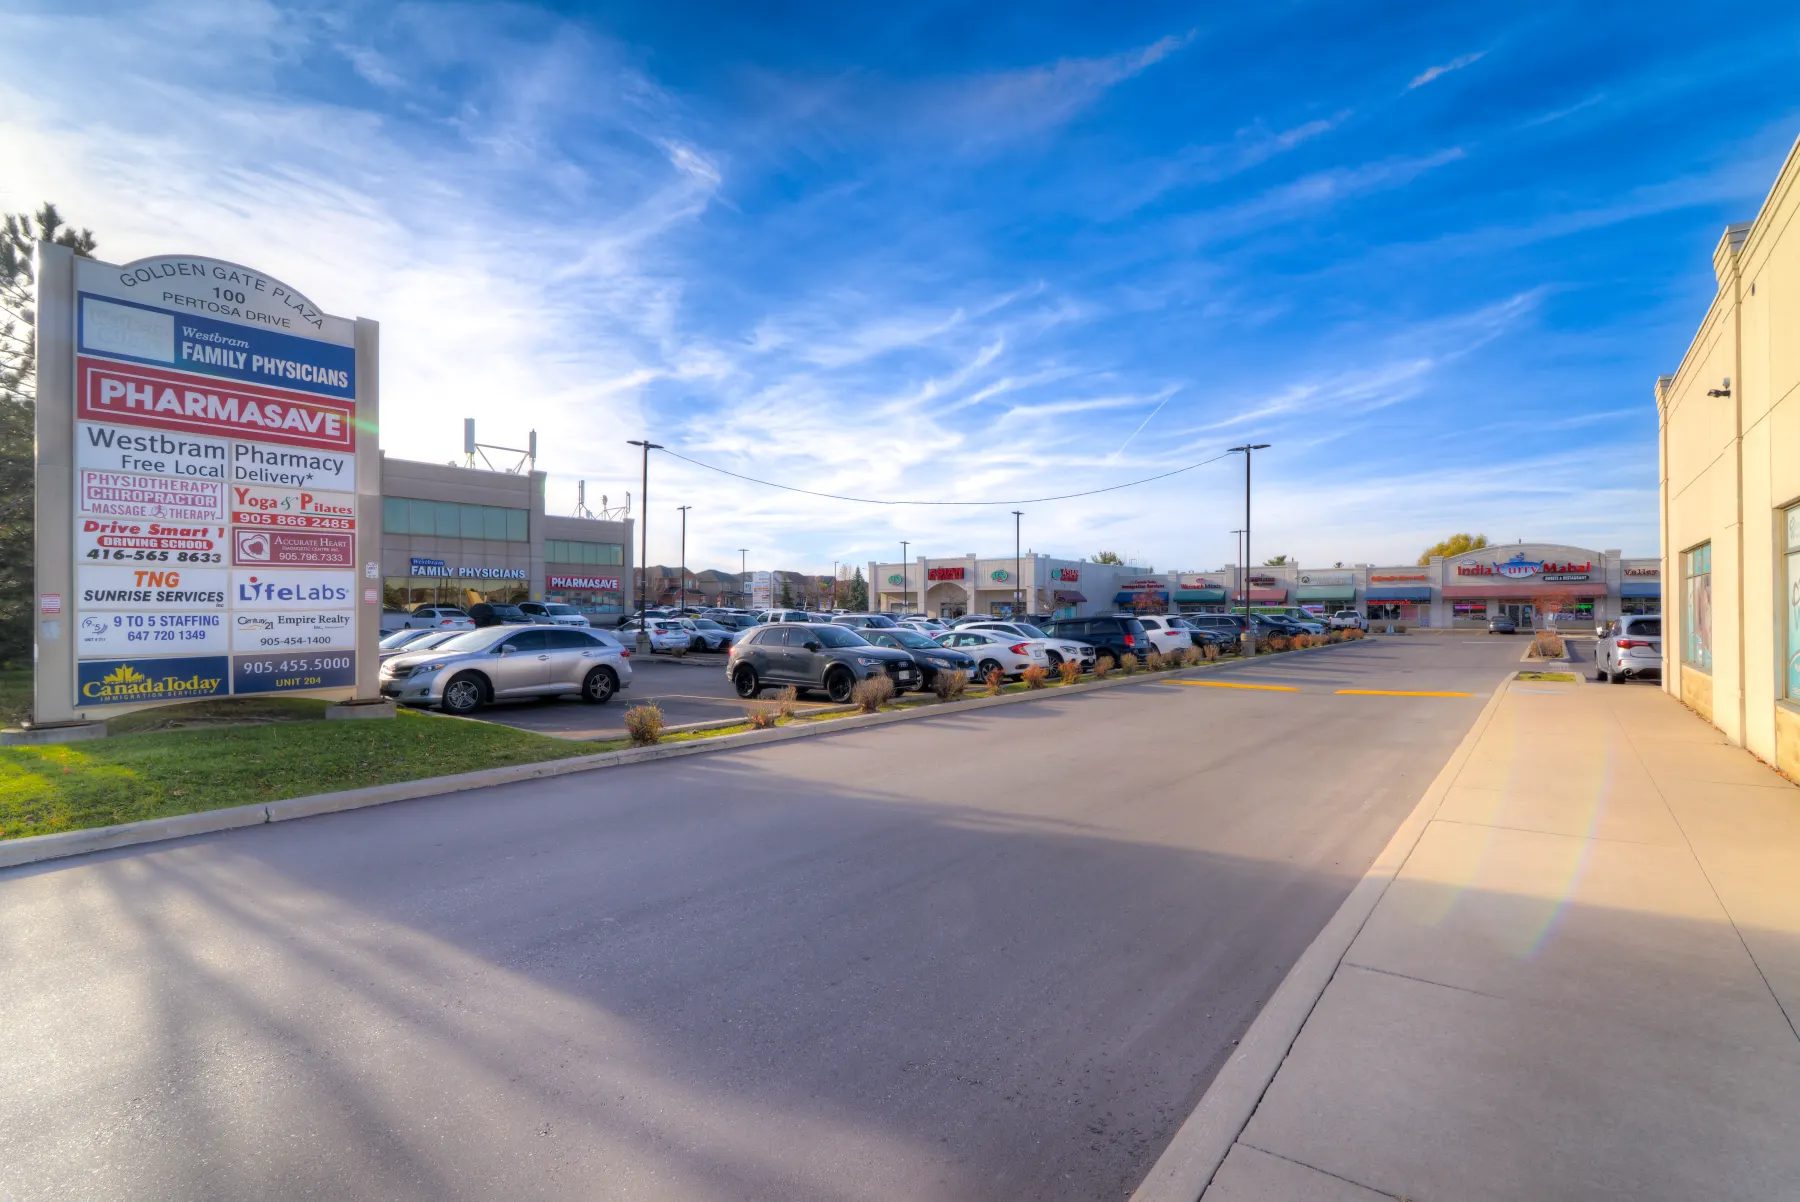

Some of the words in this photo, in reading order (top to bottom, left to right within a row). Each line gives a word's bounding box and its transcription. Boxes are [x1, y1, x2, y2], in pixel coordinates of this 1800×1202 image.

[120, 263, 206, 288] GOLDEN
[212, 267, 267, 292] GATE
[272, 287, 325, 330] PLAZA
[212, 287, 246, 304] 100
[162, 291, 241, 317] PERTOSA
[246, 310, 291, 328] DRIVE
[182, 326, 250, 348] Westbram
[182, 341, 247, 369] FAMILY
[252, 354, 349, 388] PHYSICIANS
[100, 378, 341, 436] PHARMASAVE
[87, 426, 225, 460] Westbram
[235, 444, 344, 475] Pharmacy
[121, 455, 165, 473] Free
[175, 457, 225, 478] Local
[87, 473, 218, 494] PHYSIOTHERAPY
[90, 487, 216, 507] CHIROPRACTOR
[234, 487, 278, 510] Yoga
[281, 496, 299, 511] &
[300, 493, 353, 514] Pilates
[92, 503, 147, 517] MASSAGE
[169, 508, 217, 520] THERAPY
[83, 520, 141, 535] Drive
[148, 523, 209, 537] Smart
[240, 514, 271, 524] 905
[277, 515, 307, 526] 866
[312, 518, 350, 529] 2485
[103, 536, 158, 548] DRIVING
[161, 539, 209, 550] SCHOOL
[274, 536, 318, 547] ACCURATE
[320, 537, 347, 548] HEART
[87, 549, 169, 561] 416-565
[177, 552, 222, 563] 8633
[279, 552, 343, 562] 905.796.7333
[412, 558, 444, 566] Westbram
[411, 565, 454, 577] FAMILY
[458, 567, 526, 579] PHYSICIANS
[929, 568, 963, 577] ASIAN
[1457, 565, 1493, 576] India
[1497, 563, 1538, 576] Curry
[1543, 562, 1591, 573] Mahal
[134, 570, 180, 588] TNG
[551, 578, 618, 589] PHARMASAVE
[83, 589, 153, 602] SUNRISE
[156, 591, 225, 602] SERVICES
[239, 576, 347, 601] LifeLabs
[113, 616, 122, 627] 9
[126, 615, 144, 627] TO
[148, 615, 156, 627] 5
[160, 615, 220, 627] STAFFING
[237, 616, 268, 625] Century
[264, 621, 274, 630] 21
[278, 615, 316, 626] Empire
[318, 614, 351, 625] Realty
[127, 631, 150, 641] 647
[153, 631, 176, 641] 720
[179, 630, 206, 641] 1349
[260, 636, 331, 646] 905-454-1400
[243, 657, 350, 674] 905.455.5000
[276, 677, 301, 687] UNIT
[304, 677, 321, 686] 204
[100, 690, 164, 701] IMMIGRATION
[168, 688, 207, 697] SERVICES
